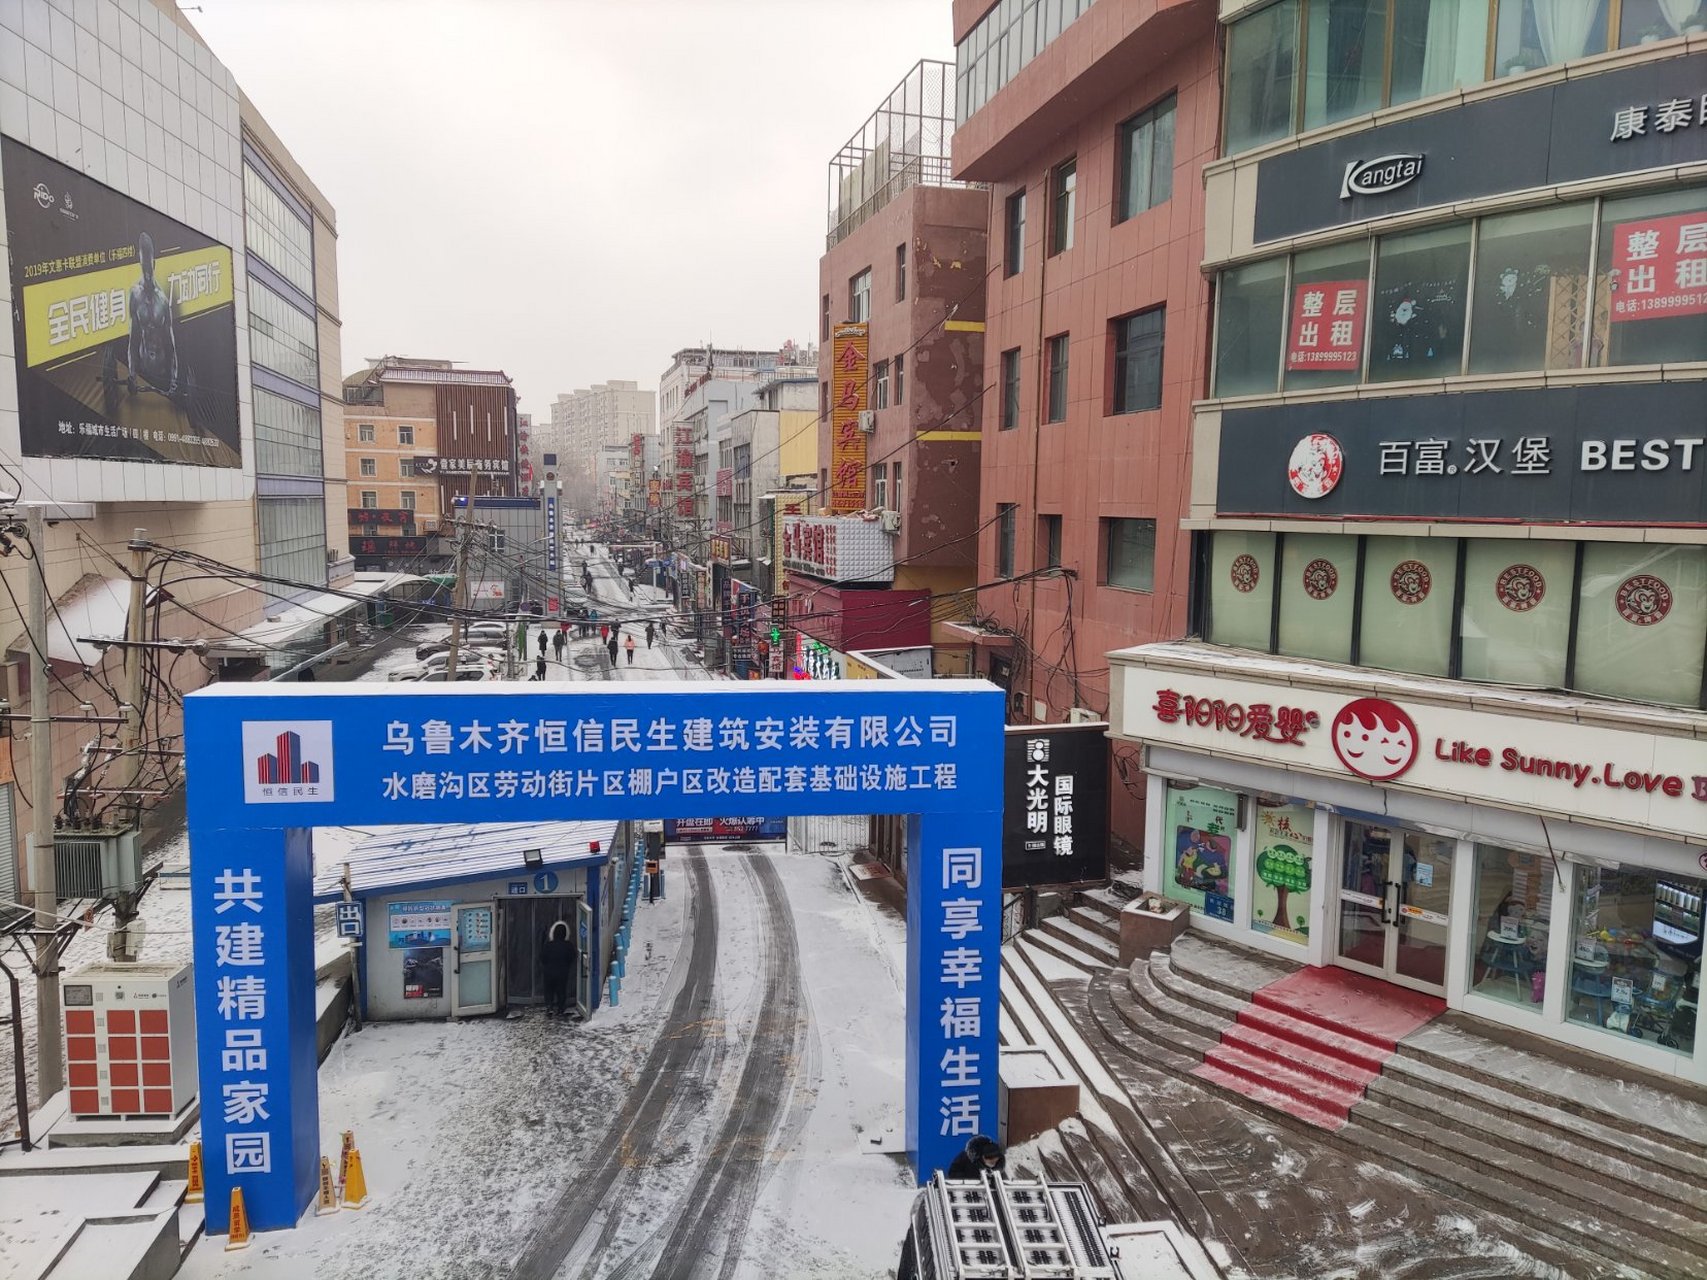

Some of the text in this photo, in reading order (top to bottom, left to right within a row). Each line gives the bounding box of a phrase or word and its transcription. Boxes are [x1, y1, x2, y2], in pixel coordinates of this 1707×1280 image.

[1610, 94, 1707, 142] 康泰
[1340, 153, 1423, 199] Kangtai
[1626, 223, 1707, 261] 整层
[1627, 258, 1707, 294] 出租
[47, 288, 126, 346] 全民健身
[1301, 289, 1358, 317] 整层
[1299, 320, 1353, 347] 出租
[837, 341, 866, 489] 金马宾馆
[1580, 438, 1704, 471] BEST
[382, 715, 957, 755] 乌鲁木齐恒信民生建筑安装有限公司
[1435, 738, 1493, 767] Like
[262, 786, 319, 797] 恒信民生
[382, 763, 957, 800] 水磨沟区劳动街片区棚户区改造配套基础设施工程
[1026, 764, 1049, 834] 大光明
[1053, 775, 1073, 856] 国际眼镜
[339, 904, 360, 937] 出口
[940, 847, 983, 1137] 同享幸福生活
[213, 868, 271, 1175] 共建精品家园
